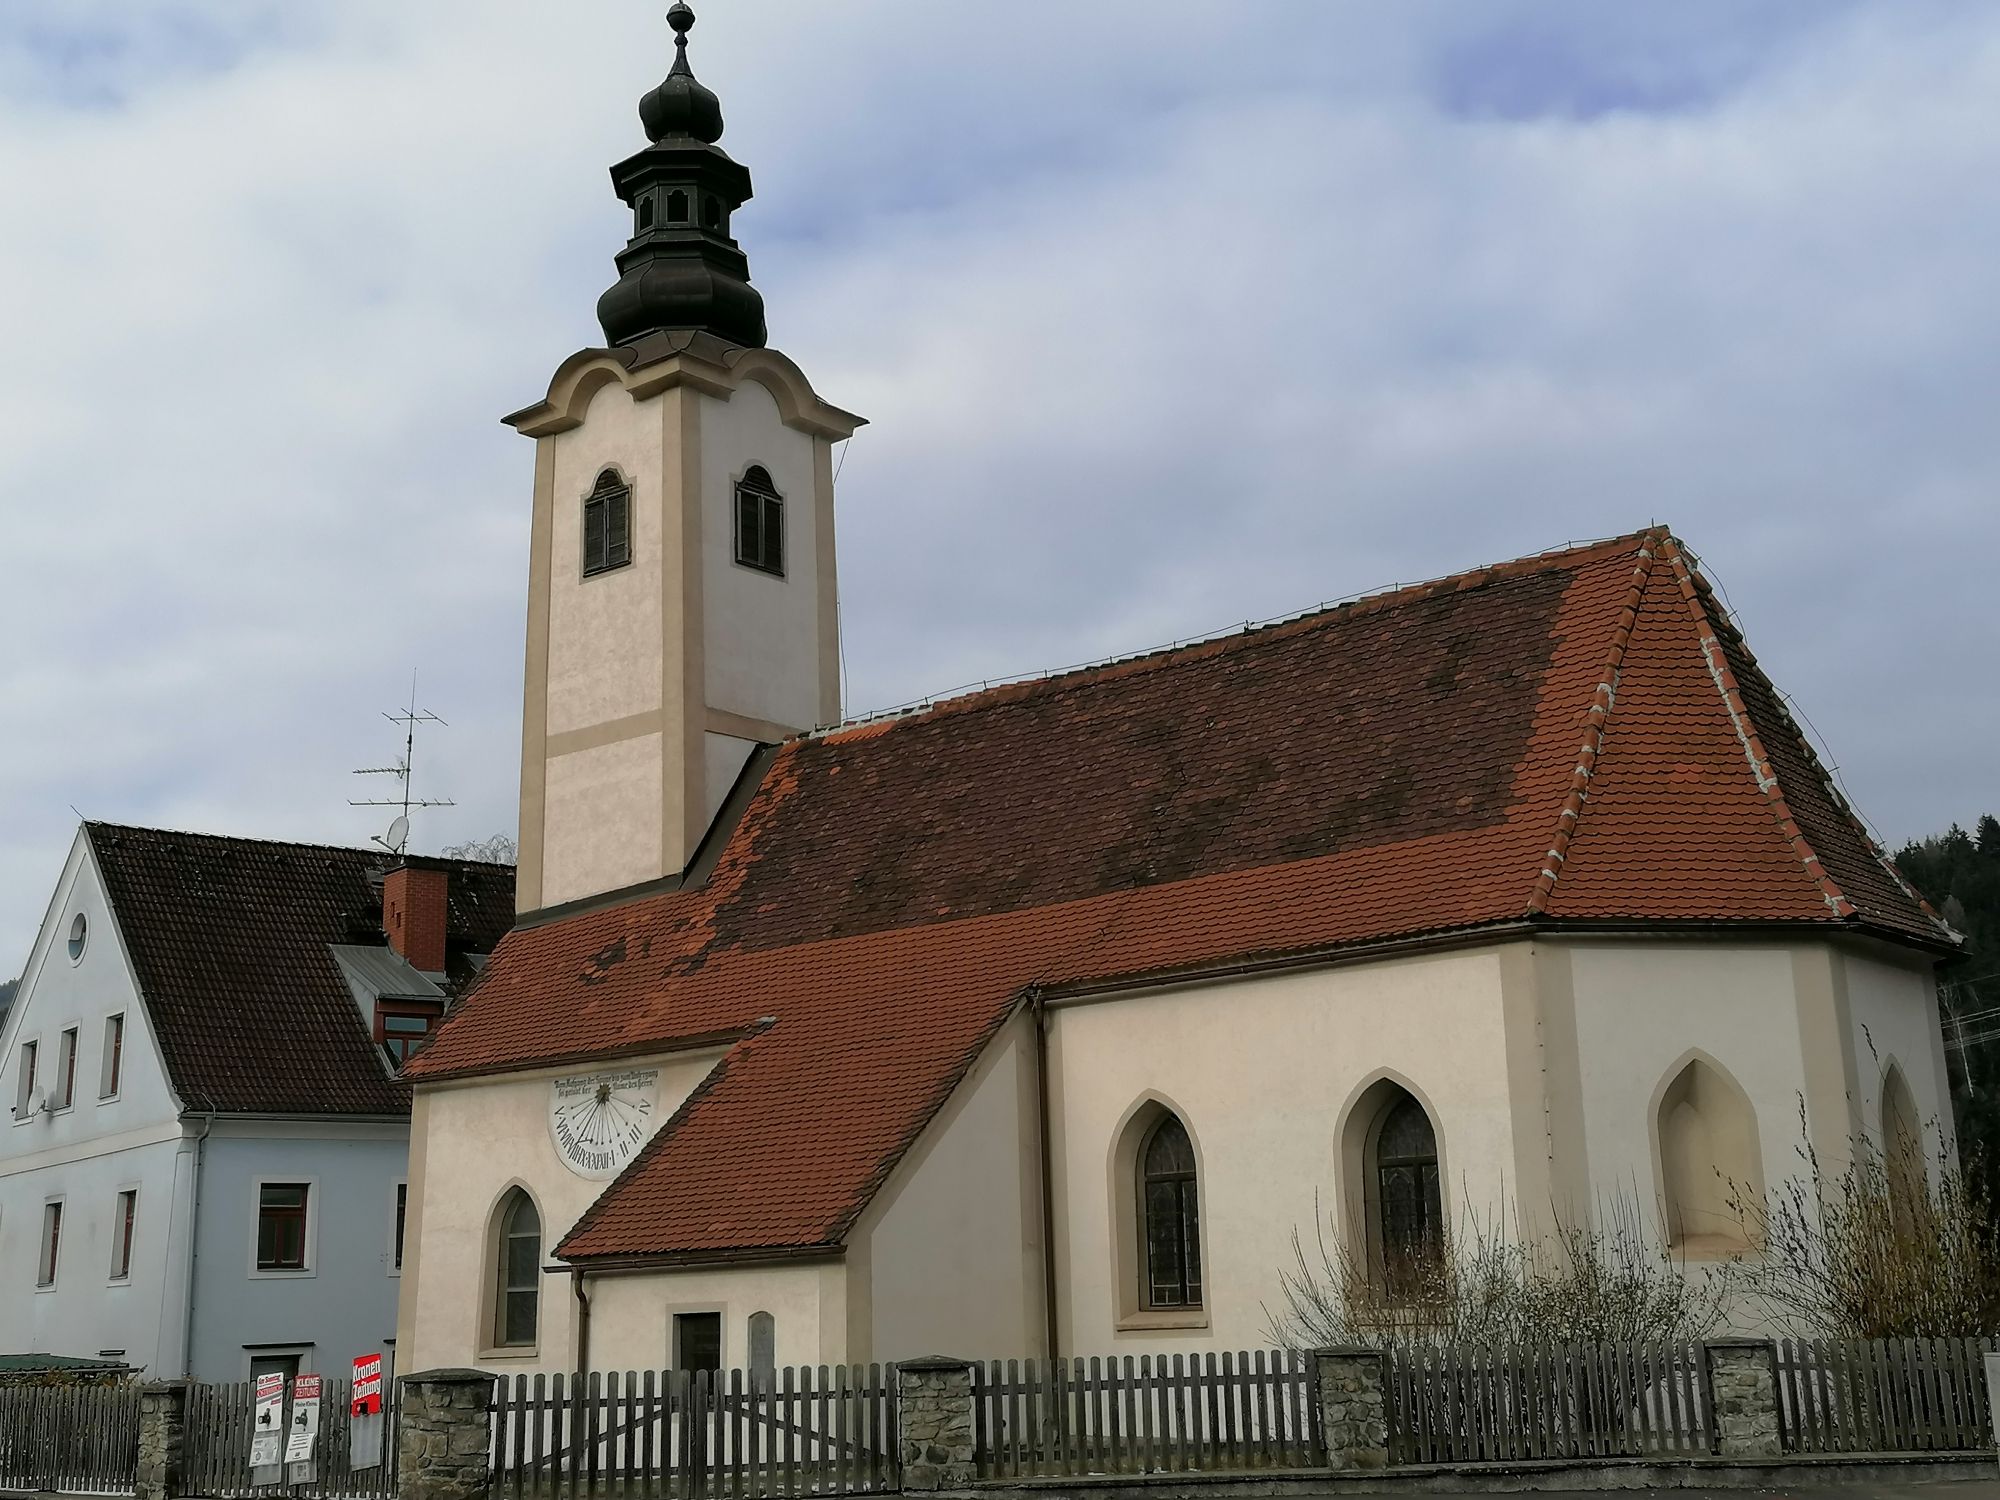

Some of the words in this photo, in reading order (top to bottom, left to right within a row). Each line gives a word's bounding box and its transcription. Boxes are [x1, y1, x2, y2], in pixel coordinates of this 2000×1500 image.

[619, 1140, 629, 1158] II
[628, 1123, 643, 1145] III
[638, 1098, 651, 1116] IV
[352, 1360, 381, 1382] Kronen
[295, 1386, 320, 1397] ZEITUNG
[296, 1377, 320, 1388] KLEINE
[353, 1378, 381, 1401] Zeitung
